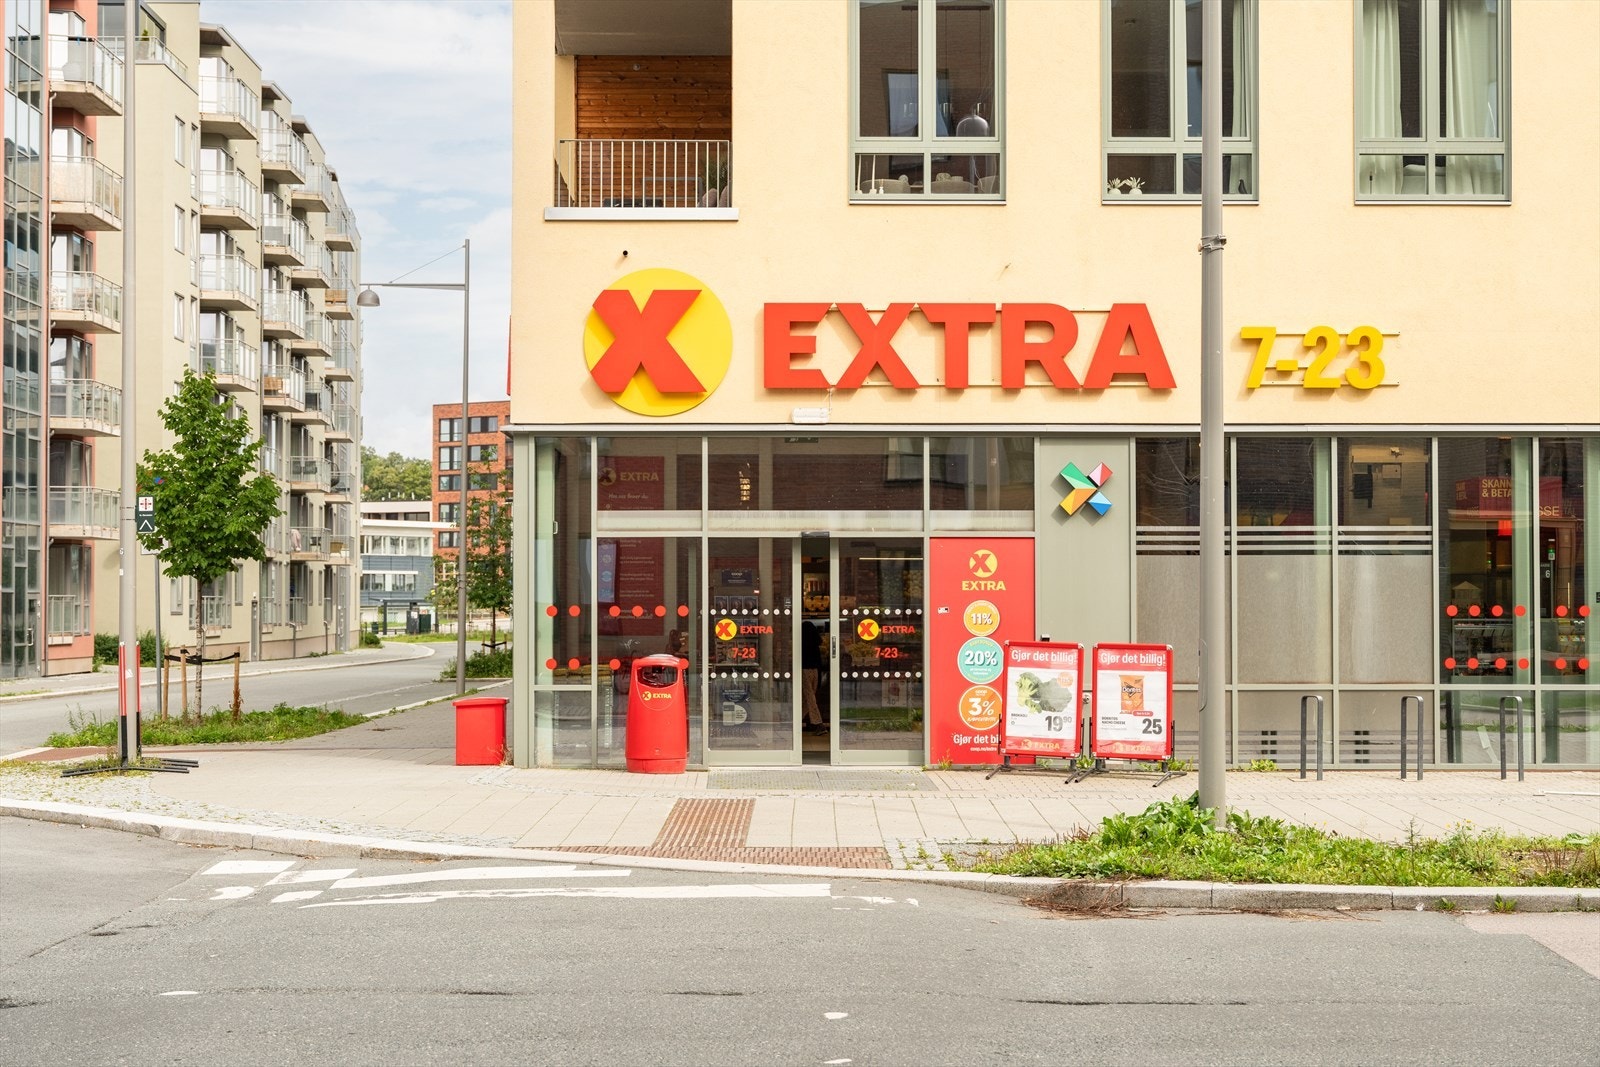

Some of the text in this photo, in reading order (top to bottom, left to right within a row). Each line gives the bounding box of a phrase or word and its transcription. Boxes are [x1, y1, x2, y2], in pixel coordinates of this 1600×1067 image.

[590, 289, 1176, 393] X EXTRA
[1240, 325, 1385, 389] 7-23
[620, 471, 659, 481] EXTRA
[1481, 488, 1489, 498] &
[1545, 569, 1551, 578] 6
[962, 580, 1006, 591] EXTRA
[971, 613, 993, 625] 11%
[740, 625, 773, 634] EXTRA
[882, 625, 915, 634] EXTRA
[732, 647, 756, 659] 7-23
[874, 647, 898, 659] 7-23
[964, 650, 998, 666] 20%
[1011, 649, 1077, 664] Gjør det billig!
[1100, 652, 1166, 667] Gjør det billig!
[968, 697, 995, 716] 3%
[1142, 718, 1163, 735] 25
[953, 734, 971, 746] Gjør
[974, 735, 989, 744] det
[1034, 742, 1060, 750] EXTRA
